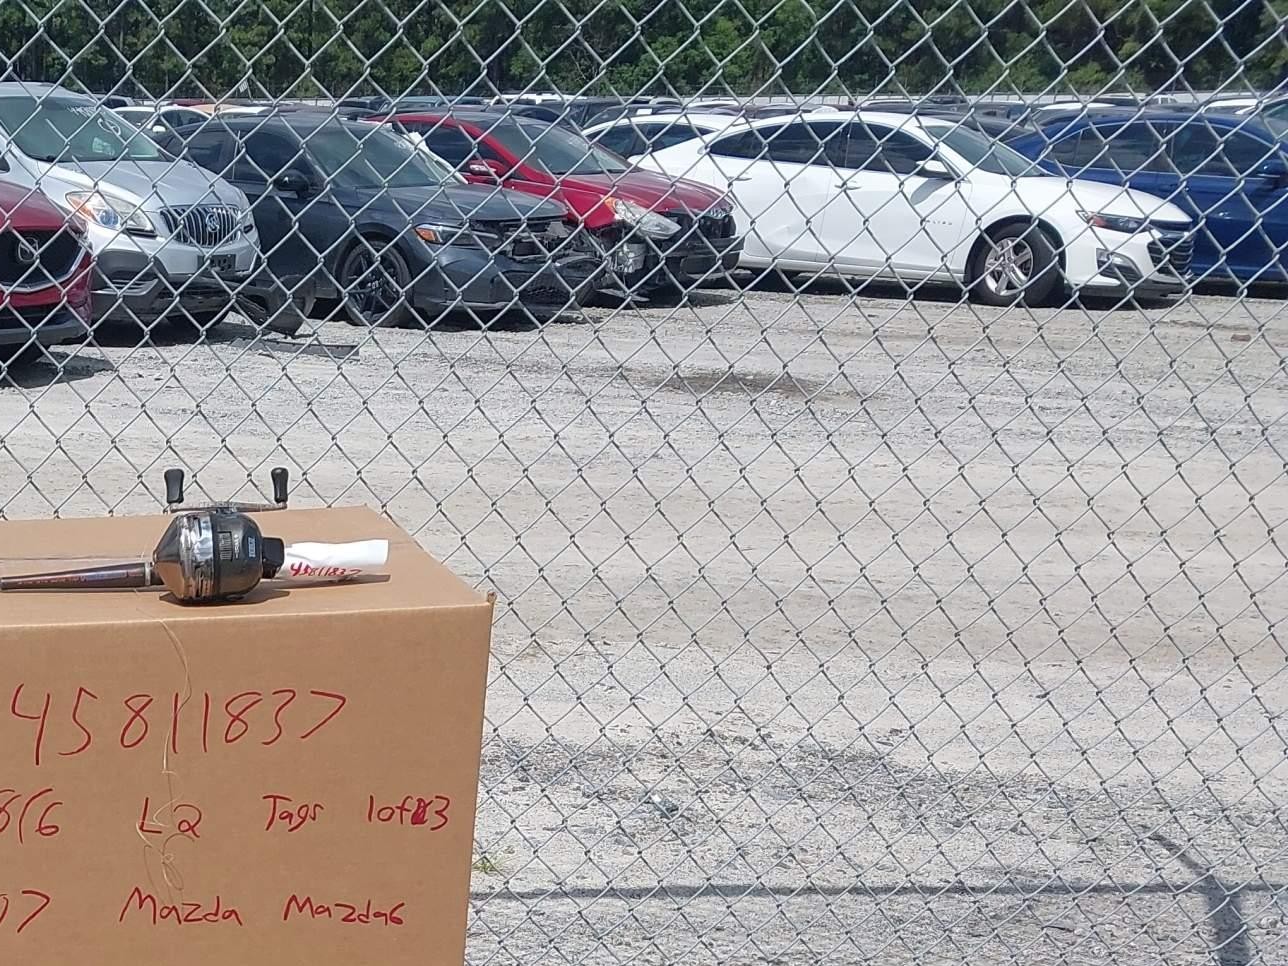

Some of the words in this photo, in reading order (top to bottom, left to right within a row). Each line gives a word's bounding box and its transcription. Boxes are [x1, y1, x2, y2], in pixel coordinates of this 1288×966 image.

[11, 683, 347, 766] 45811837
[262, 794, 325, 833] Tags
[119, 886, 244, 926] Mazda
[283, 894, 406, 926] Mazda6
